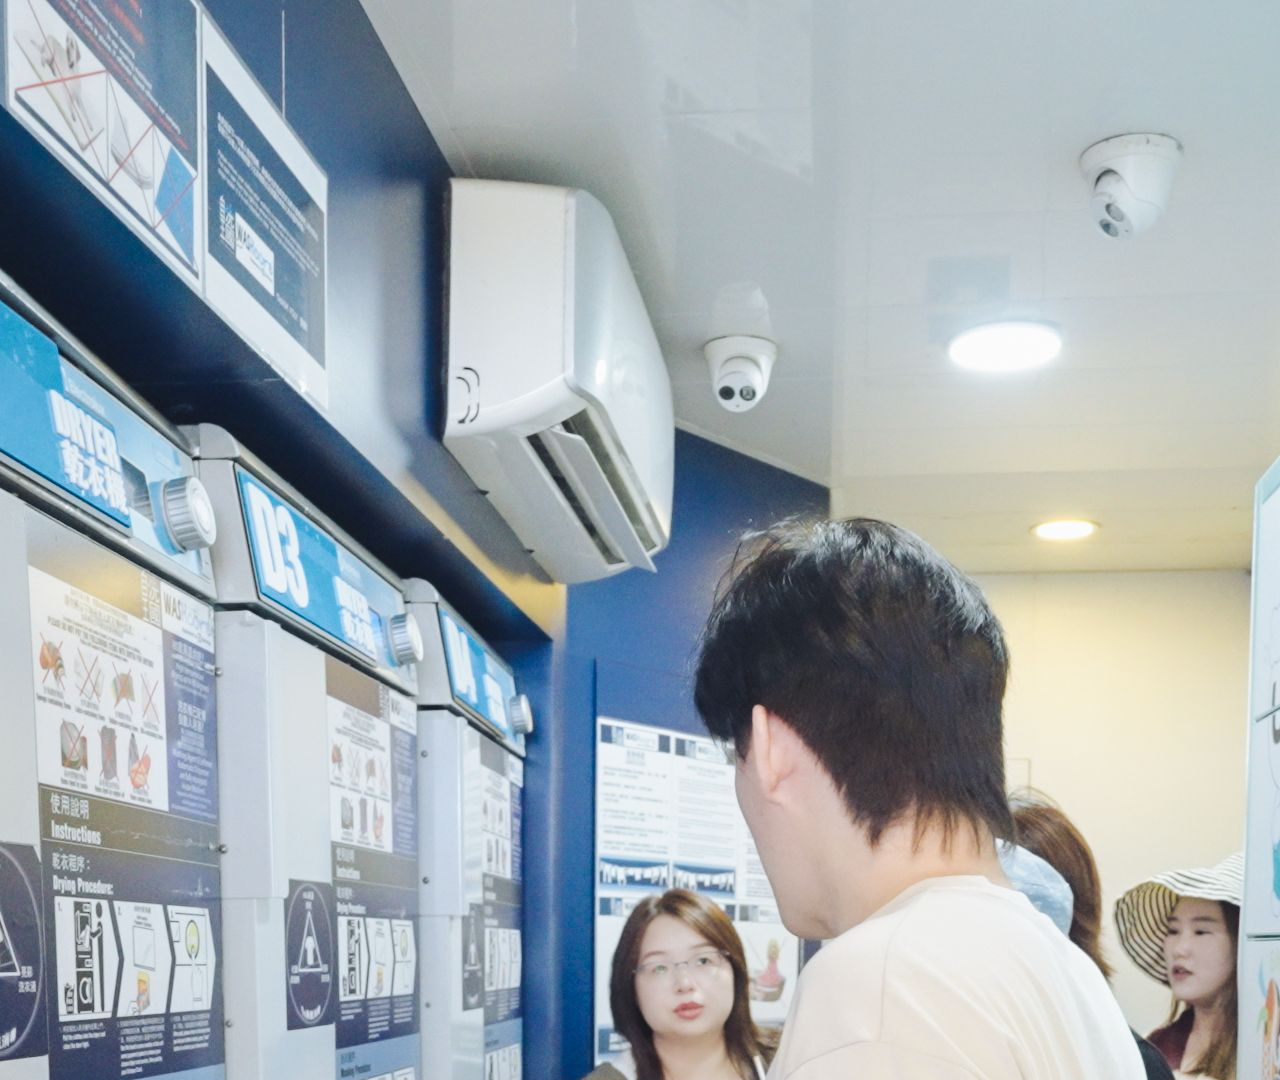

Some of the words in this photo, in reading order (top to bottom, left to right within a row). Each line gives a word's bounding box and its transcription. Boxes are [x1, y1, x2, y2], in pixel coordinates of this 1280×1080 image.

[246, 481, 310, 608] D3
[50, 792, 91, 821] 使用說明
[51, 819, 102, 846] Instructions
[52, 873, 76, 895] Drying
[77, 876, 114, 896] Procedure:
